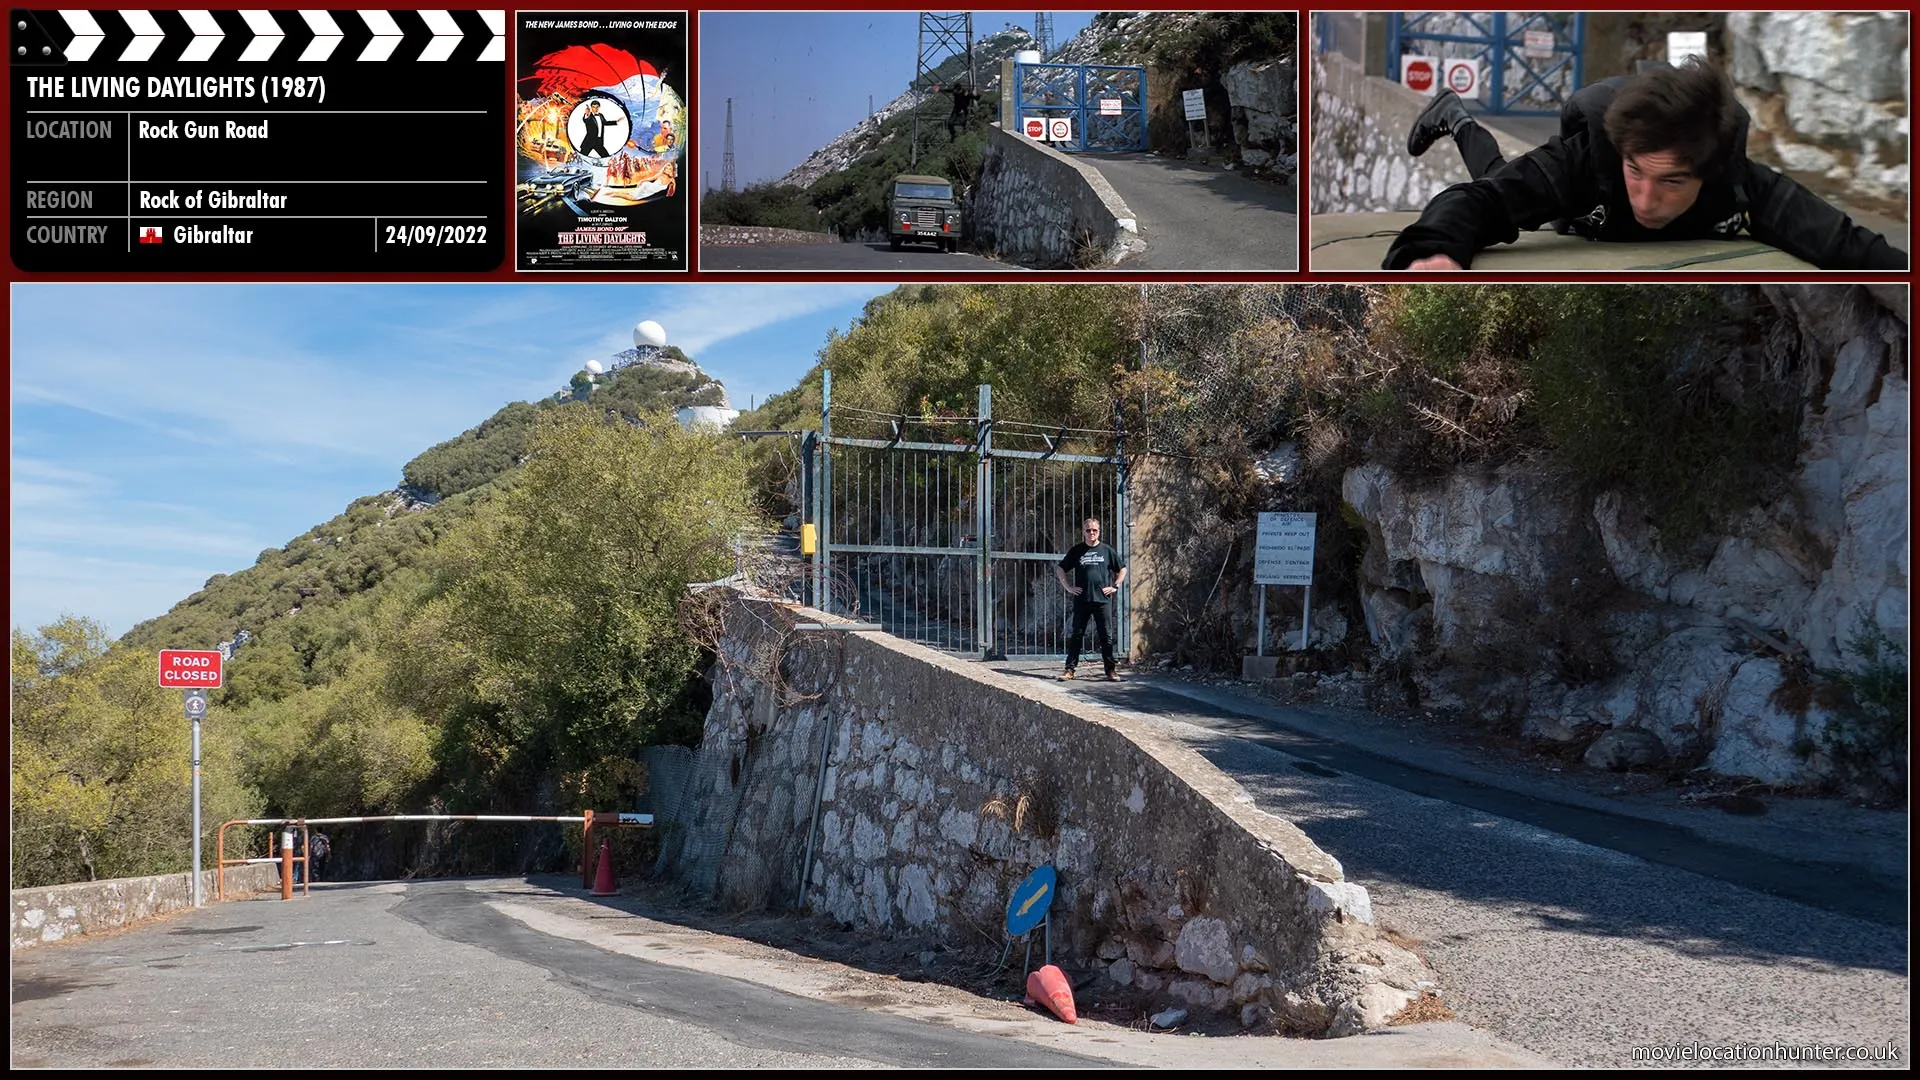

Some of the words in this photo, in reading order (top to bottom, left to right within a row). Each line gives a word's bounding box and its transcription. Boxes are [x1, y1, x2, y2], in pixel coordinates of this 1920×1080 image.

[525, 20, 538, 29] THE
[538, 20, 555, 29] NEW
[555, 20, 578, 29] JAMES
[577, 20, 599, 29] BOND
[609, 20, 633, 29] LIVING
[633, 20, 645, 29] ON
[645, 20, 658, 29] THE
[658, 20, 678, 29] EDGE
[557, 231, 574, 244] THE
[575, 231, 603, 244] LIVING
[603, 231, 646, 244] DAYLIGHTS
[173, 656, 210, 667] ROAD
[164, 670, 218, 681] CLOSED
